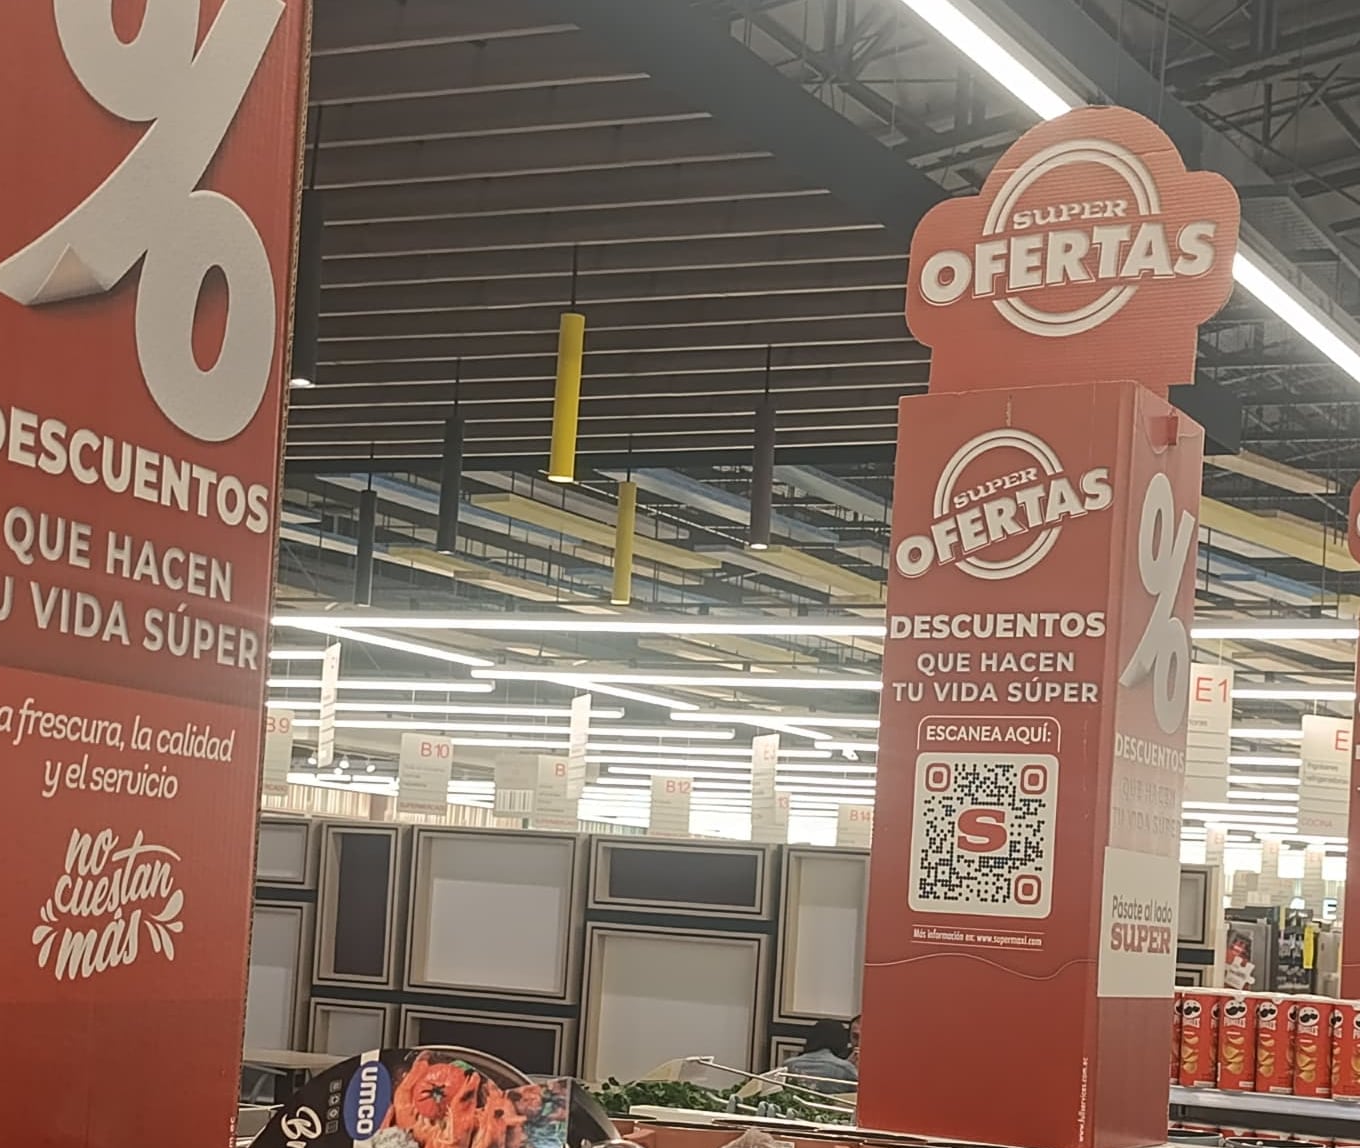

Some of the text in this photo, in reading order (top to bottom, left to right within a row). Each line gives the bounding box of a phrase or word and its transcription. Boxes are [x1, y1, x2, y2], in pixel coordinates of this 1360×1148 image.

[1012, 199, 1127, 230] SUPER
[919, 220, 1217, 307] OFERTAS
[952, 466, 1038, 509] SUPER
[895, 467, 1114, 578] OFERTAS
[3, 505, 233, 603] QUE HACEN
[29, 581, 131, 646] VIDA
[142, 602, 261, 672] SÚPER
[890, 611, 1106, 640] DESCUENTOS
[916, 651, 1075, 676] QUE HACEN
[892, 676, 1099, 703] TU VIDA SÚPER
[1195, 676, 1228, 703] E1
[13, 700, 125, 749] frescura,
[130, 714, 154, 749] la
[155, 725, 236, 763] calidad
[420, 742, 450, 759] B10
[925, 721, 1052, 743] ESCANEA AQUÍ:
[1115, 733, 1185, 770] DESCUENTOS
[42, 755, 179, 799] y el servicio
[666, 780, 691, 795] B12
[65, 826, 118, 876] no
[956, 808, 1007, 853] S
[53, 830, 181, 917] cuestan
[1112, 894, 1173, 923] Pásate al lado
[55, 911, 143, 982] más
[1110, 921, 1172, 955] SUPER
[356, 1066, 378, 1135] umco
